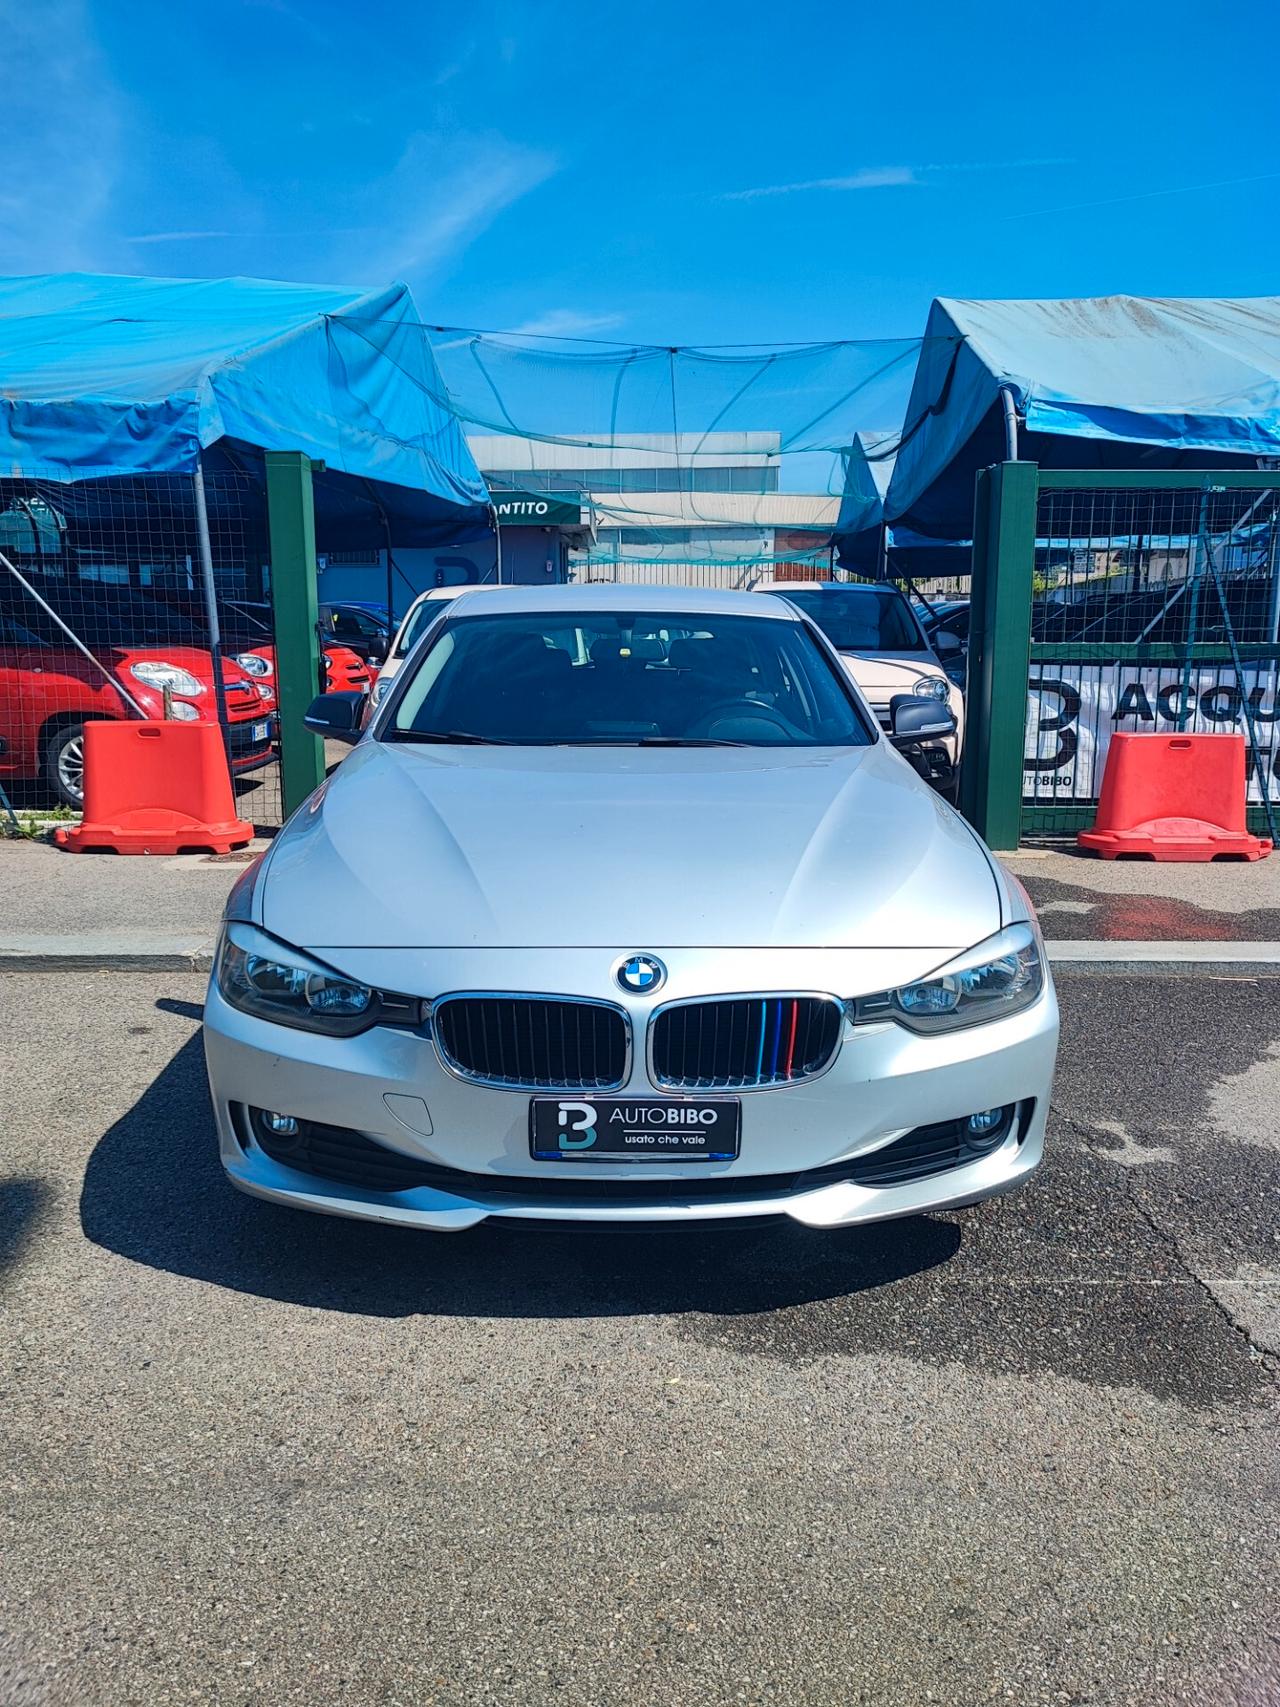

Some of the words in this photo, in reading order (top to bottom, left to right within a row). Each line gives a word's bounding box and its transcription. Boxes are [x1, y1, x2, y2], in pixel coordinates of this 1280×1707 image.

[493, 502, 549, 515] NTITO
[1023, 775, 1072, 786] TOBIBO
[609, 1107, 718, 1125] AUTOBIBO
[625, 1134, 655, 1145] usato
[659, 1134, 679, 1145] che
[682, 1134, 706, 1145] vale
